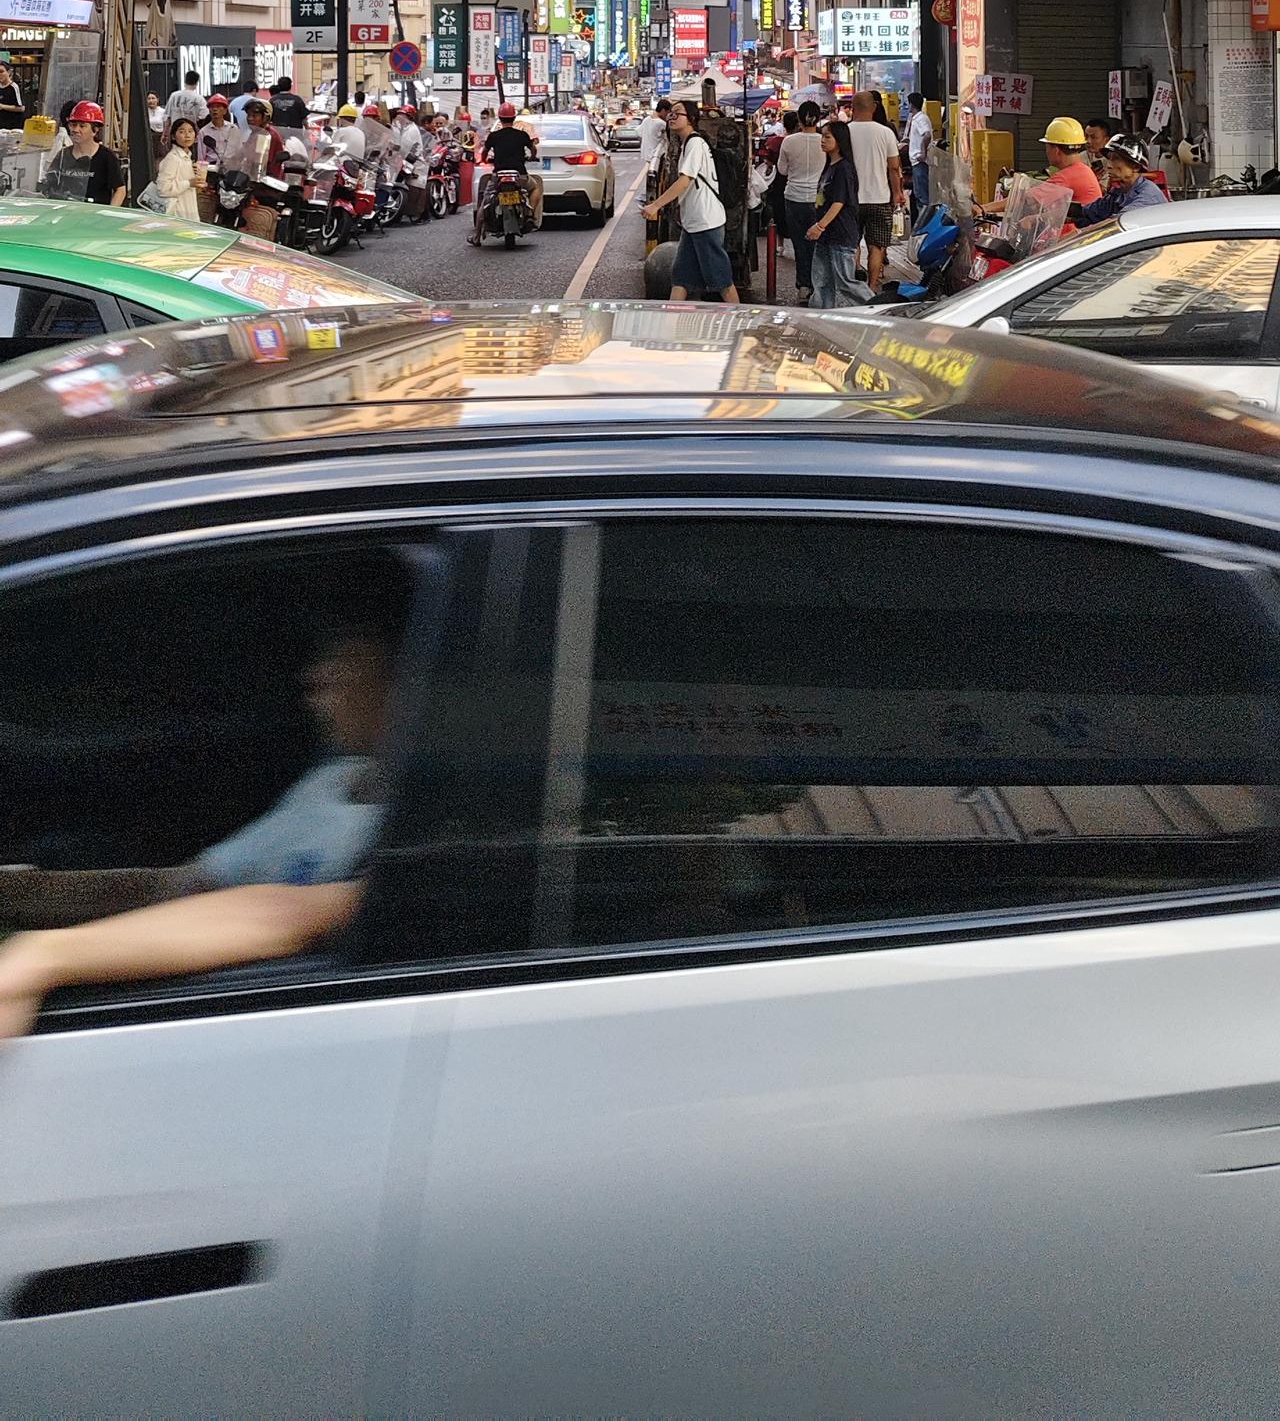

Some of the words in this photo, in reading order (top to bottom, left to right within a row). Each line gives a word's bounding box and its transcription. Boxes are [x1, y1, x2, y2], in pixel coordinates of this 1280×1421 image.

[300, 3, 326, 16] 开幕
[306, 31, 322, 42] 2F
[358, 28, 381, 40] 6F
[841, 24, 909, 37] 手机回收
[180, 45, 211, 98] DSHX
[442, 76, 454, 85] 2F
[474, 77, 490, 85] 6F
